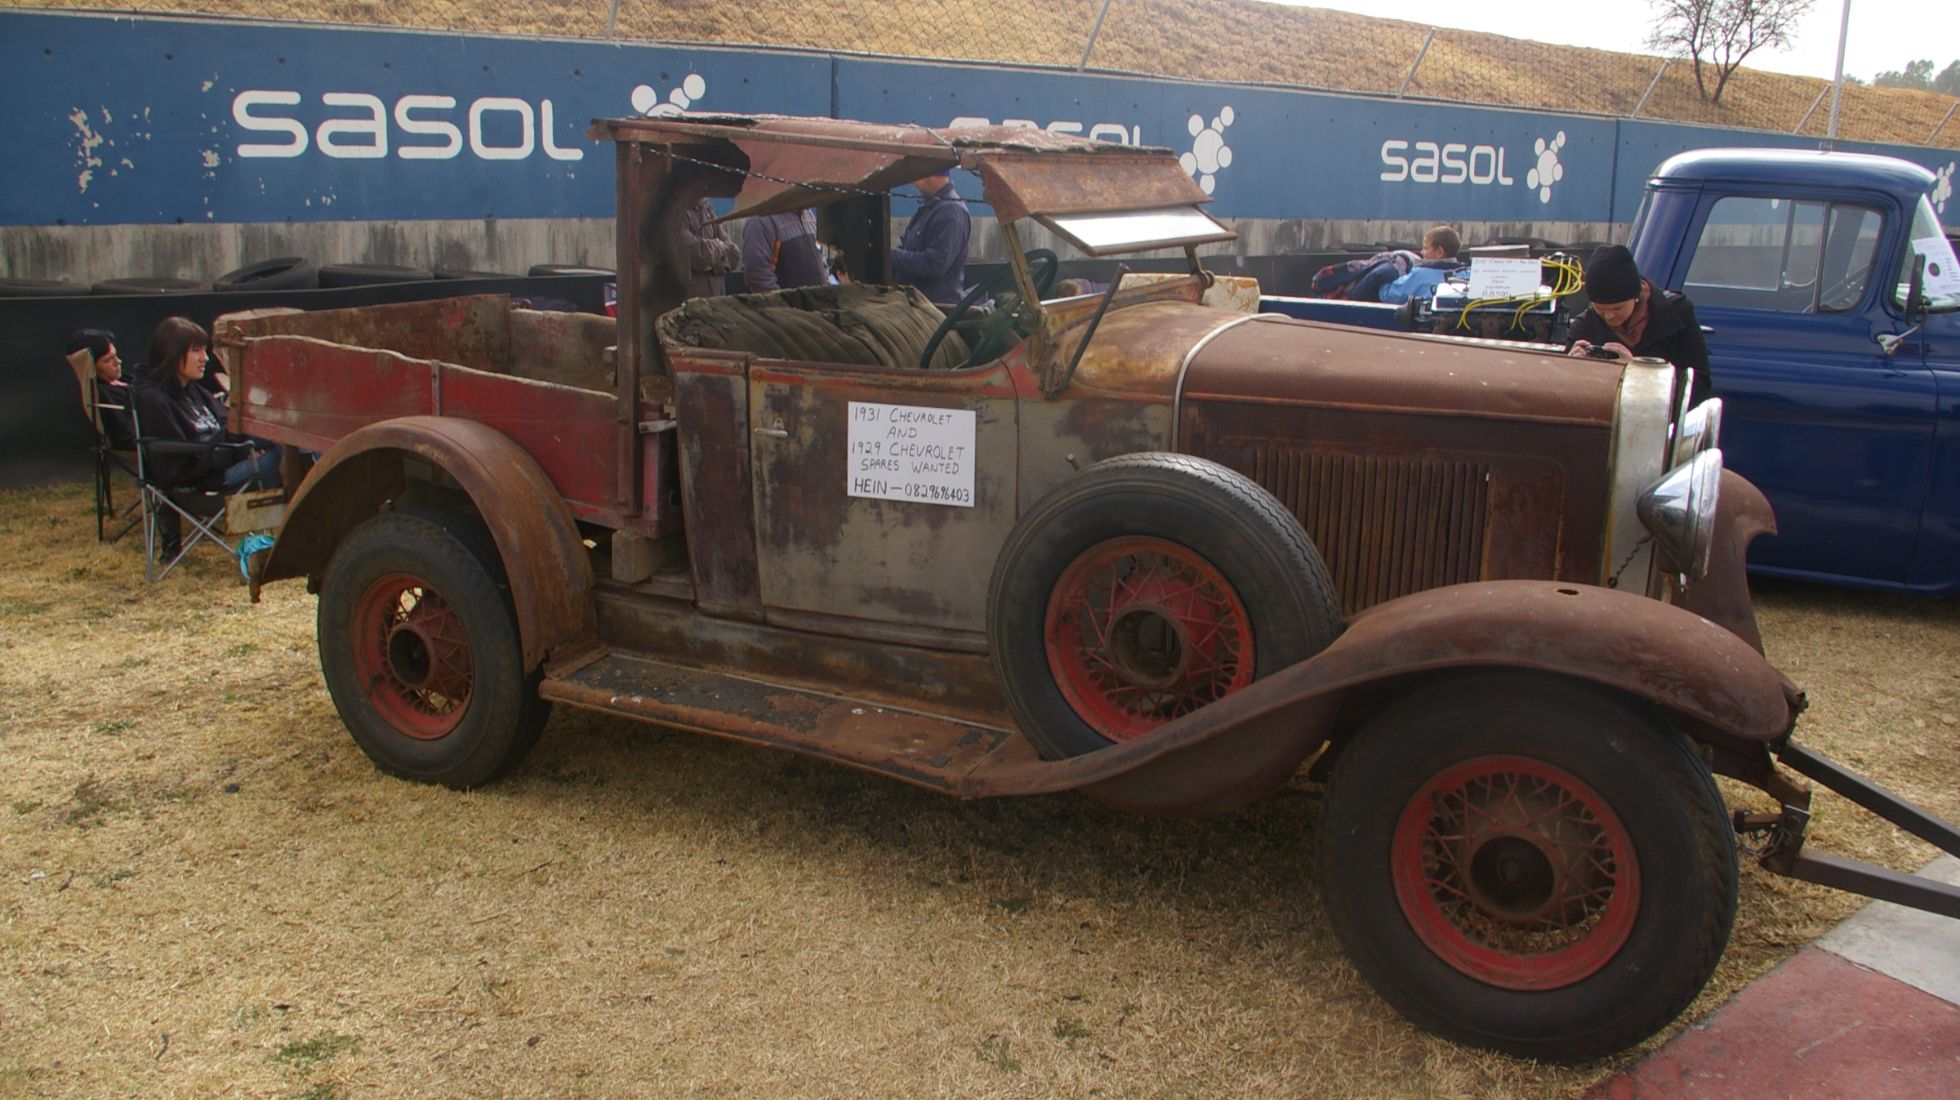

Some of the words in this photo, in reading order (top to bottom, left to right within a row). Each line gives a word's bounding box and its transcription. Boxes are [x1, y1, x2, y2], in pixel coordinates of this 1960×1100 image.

[854, 406, 880, 421] 1931
[889, 407, 953, 425] CHEVROLET
[886, 426, 918, 439] AND
[852, 441, 881, 455] 1929
[889, 442, 965, 460] CHEVROLET
[861, 458, 900, 472] SPARES
